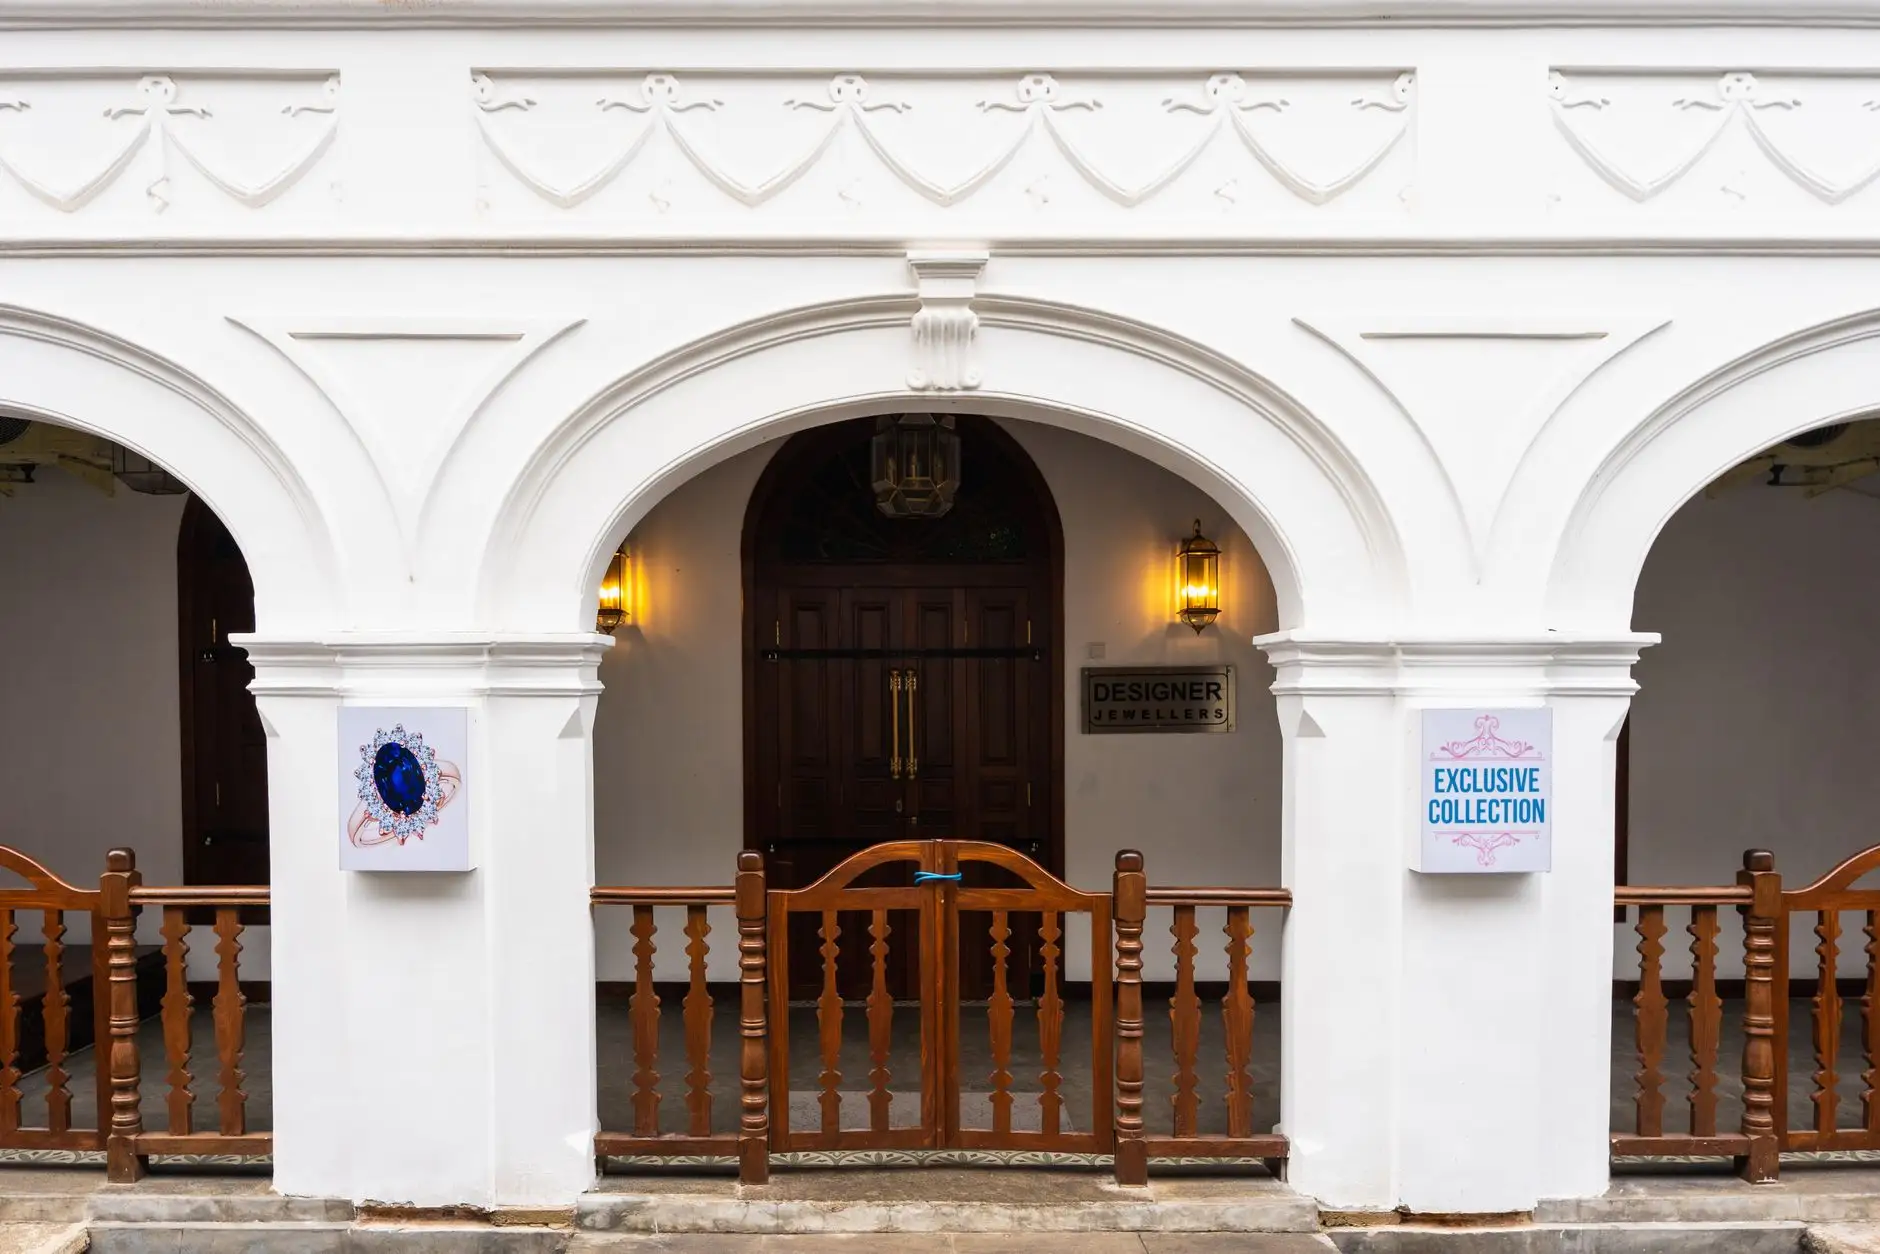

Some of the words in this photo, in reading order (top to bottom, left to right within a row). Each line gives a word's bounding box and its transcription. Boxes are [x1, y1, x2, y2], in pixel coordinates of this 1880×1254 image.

[1094, 682, 1222, 702] DESIGNER
[1094, 708, 1224, 720] JEWELLERS
[1434, 768, 1540, 793] EXCLUSIVE
[1429, 799, 1545, 824] COLLECTION
